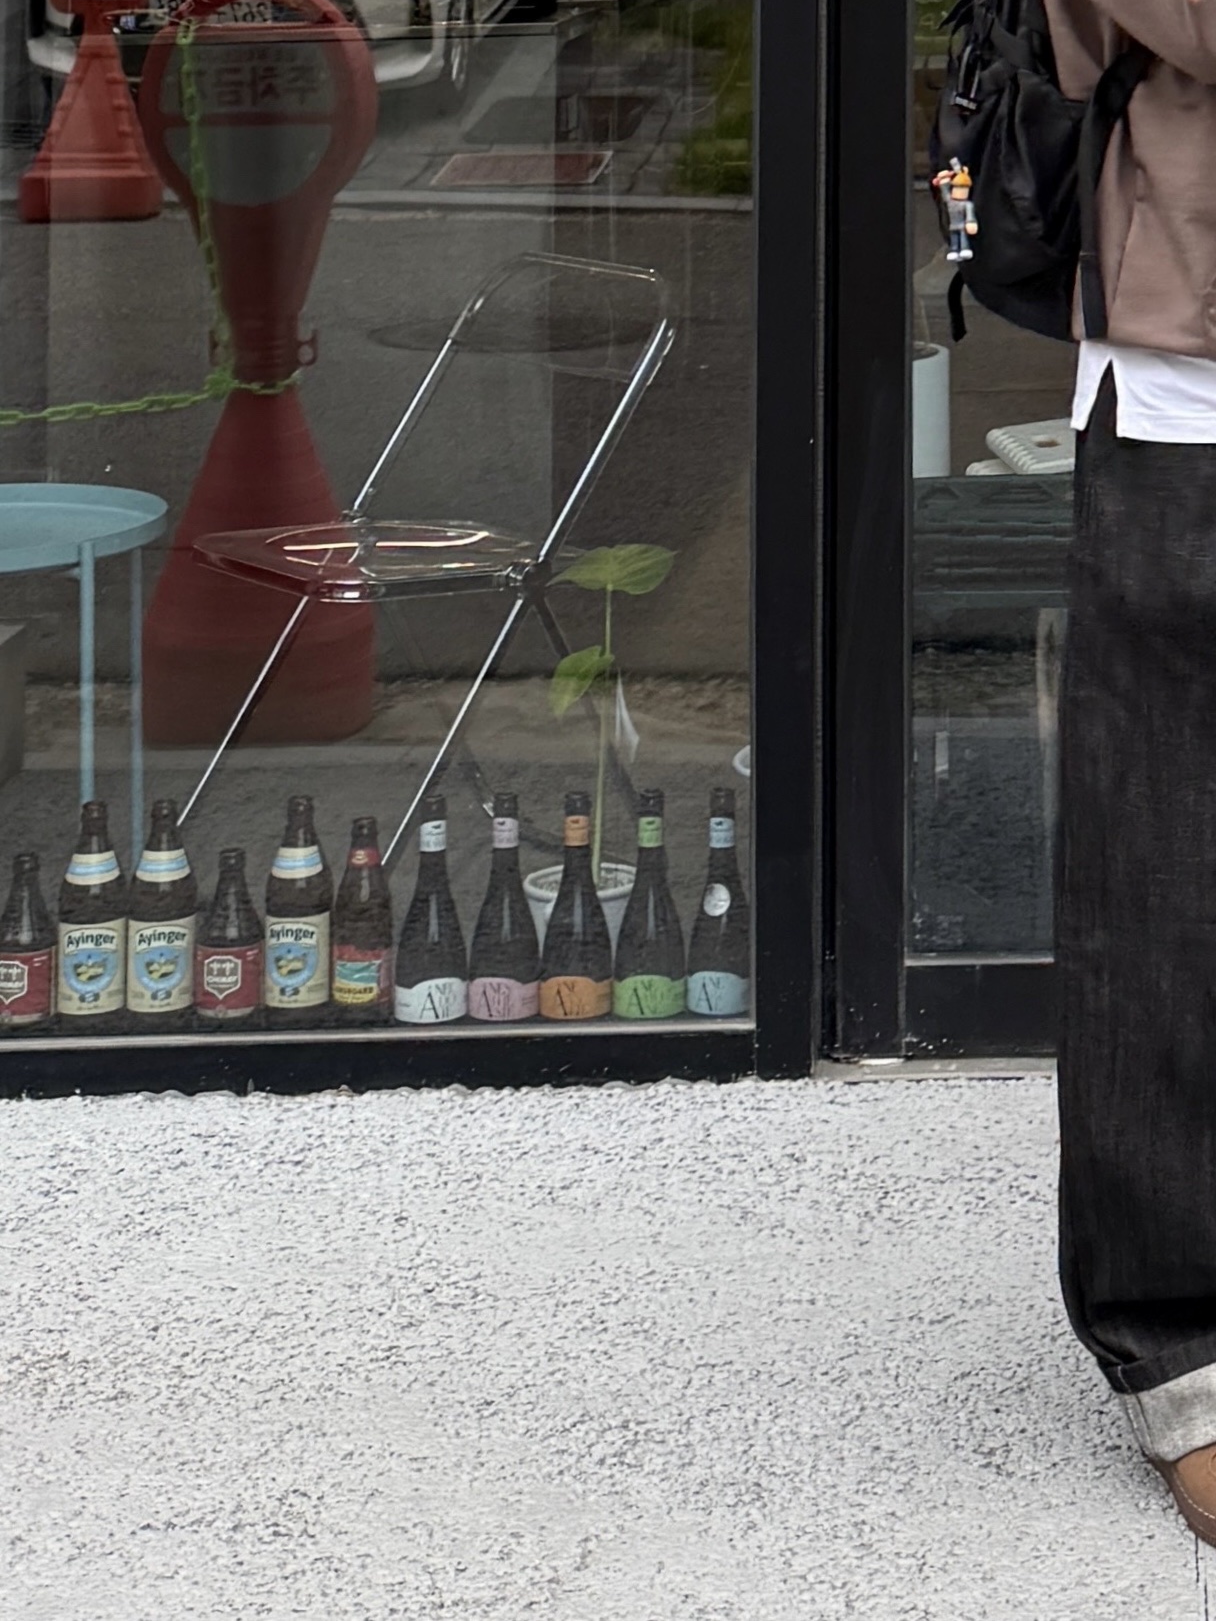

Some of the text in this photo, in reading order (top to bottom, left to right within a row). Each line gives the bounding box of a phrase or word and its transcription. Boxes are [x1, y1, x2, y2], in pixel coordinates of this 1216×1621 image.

[66, 929, 117, 949] Ayinger
[138, 928, 187, 948] Ayinger
[270, 926, 316, 945] Ayinger
